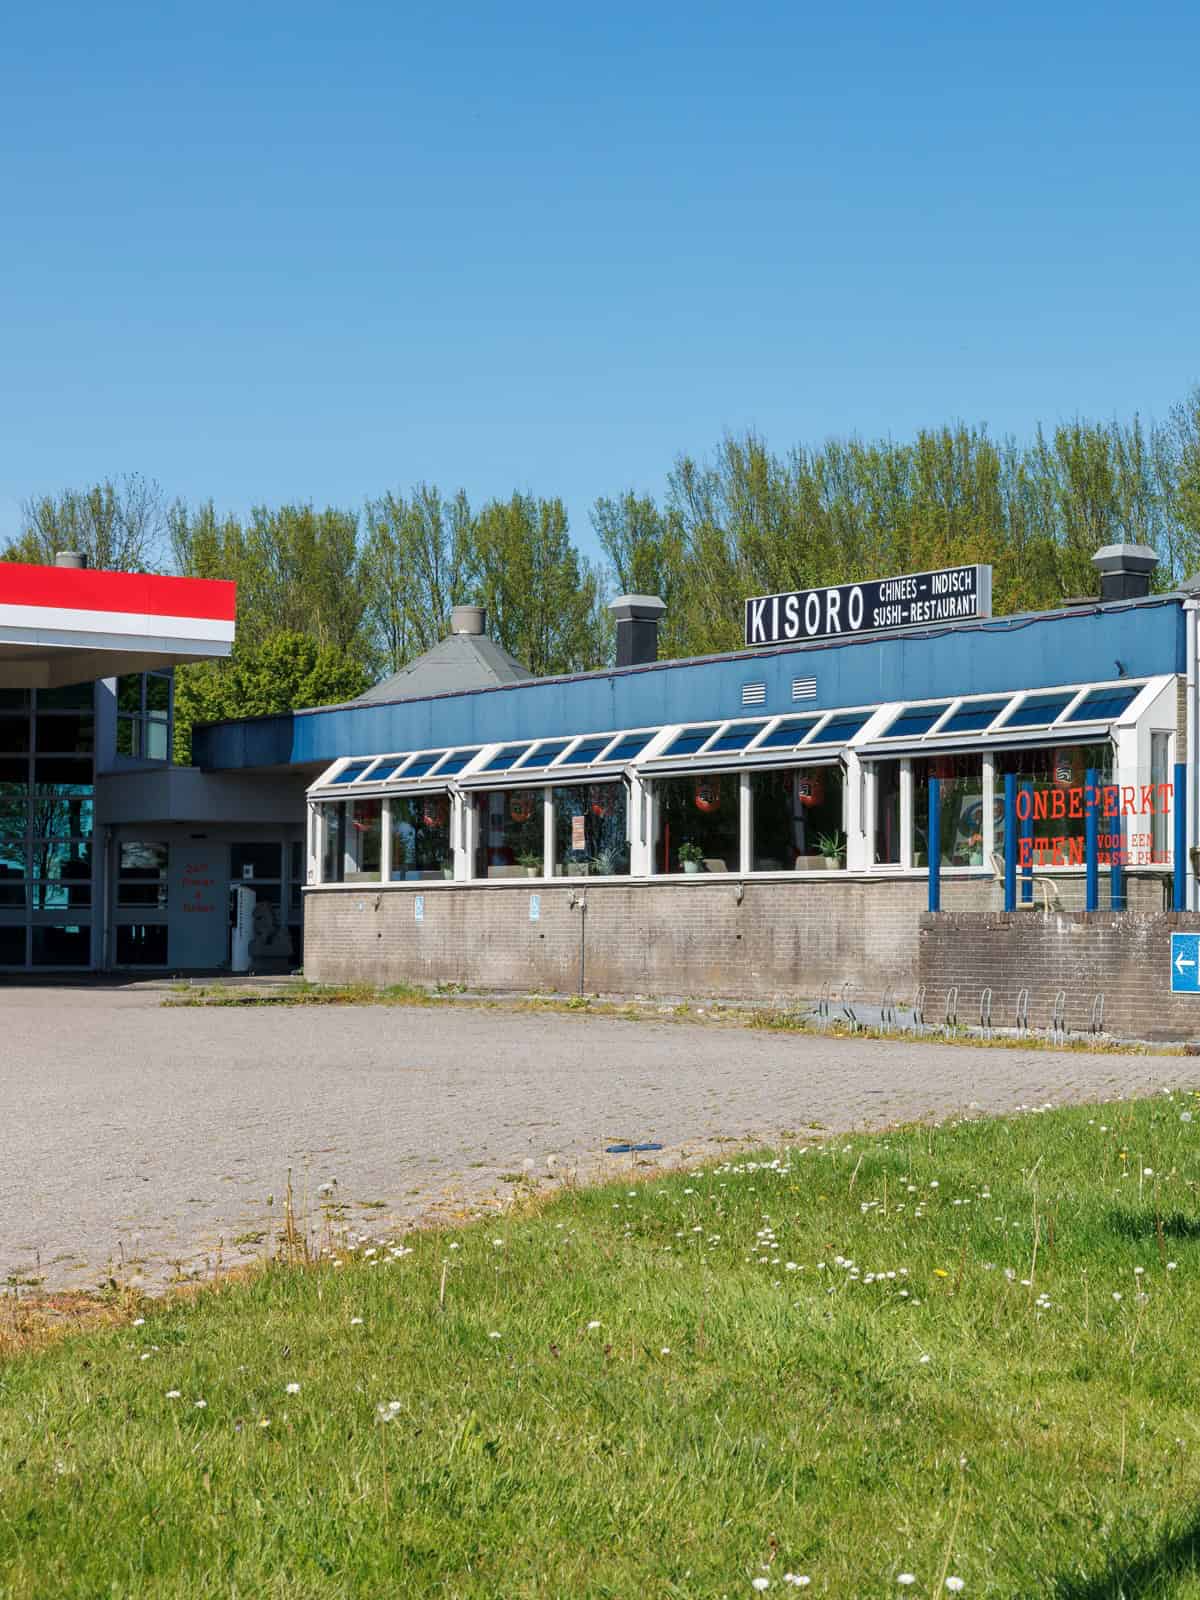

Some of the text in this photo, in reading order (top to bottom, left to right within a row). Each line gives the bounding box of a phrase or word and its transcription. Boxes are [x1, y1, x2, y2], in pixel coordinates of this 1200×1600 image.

[880, 579, 917, 601] CHINEES
[932, 571, 972, 595] INDISCH
[752, 586, 864, 642] KISORO
[1018, 836, 1085, 867] ETEN
